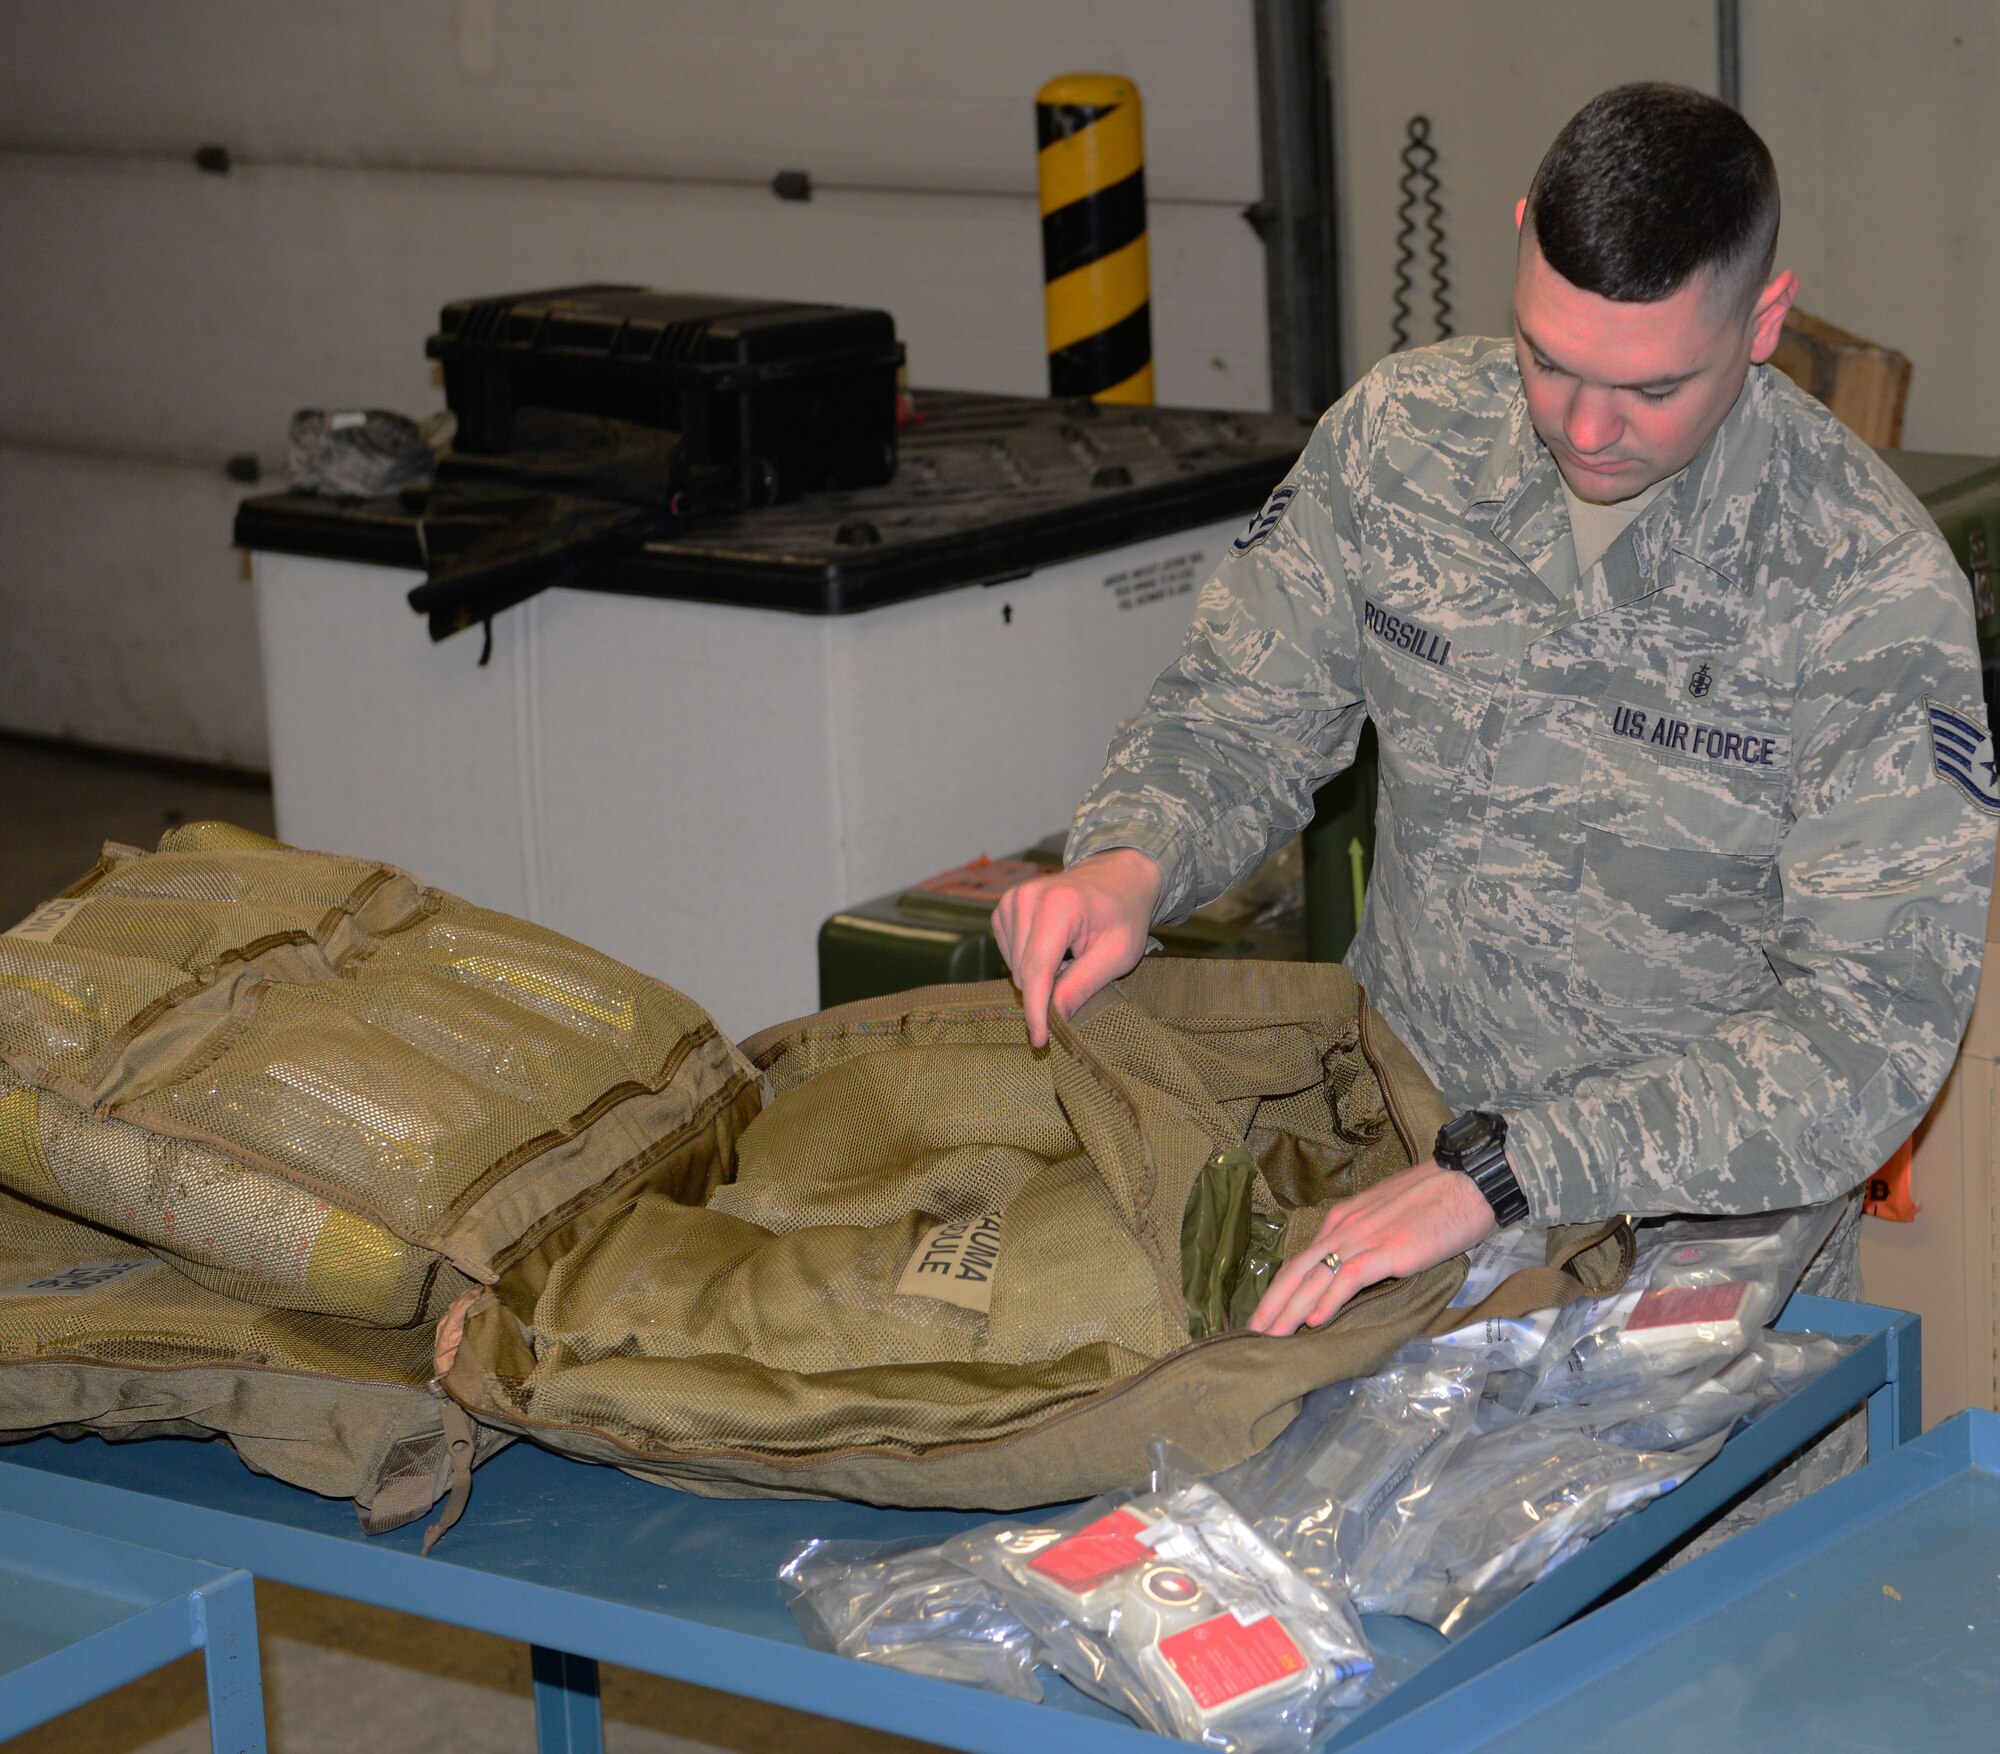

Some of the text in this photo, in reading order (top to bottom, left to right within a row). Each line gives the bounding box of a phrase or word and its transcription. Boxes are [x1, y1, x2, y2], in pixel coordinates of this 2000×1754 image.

[1364, 600, 1452, 666] ROSSILLI
[1650, 717, 1690, 751] AIR
[1692, 724, 1777, 766] FORCE
[917, 1221, 969, 1275] DULE
[954, 1211, 1002, 1282] AUMA
